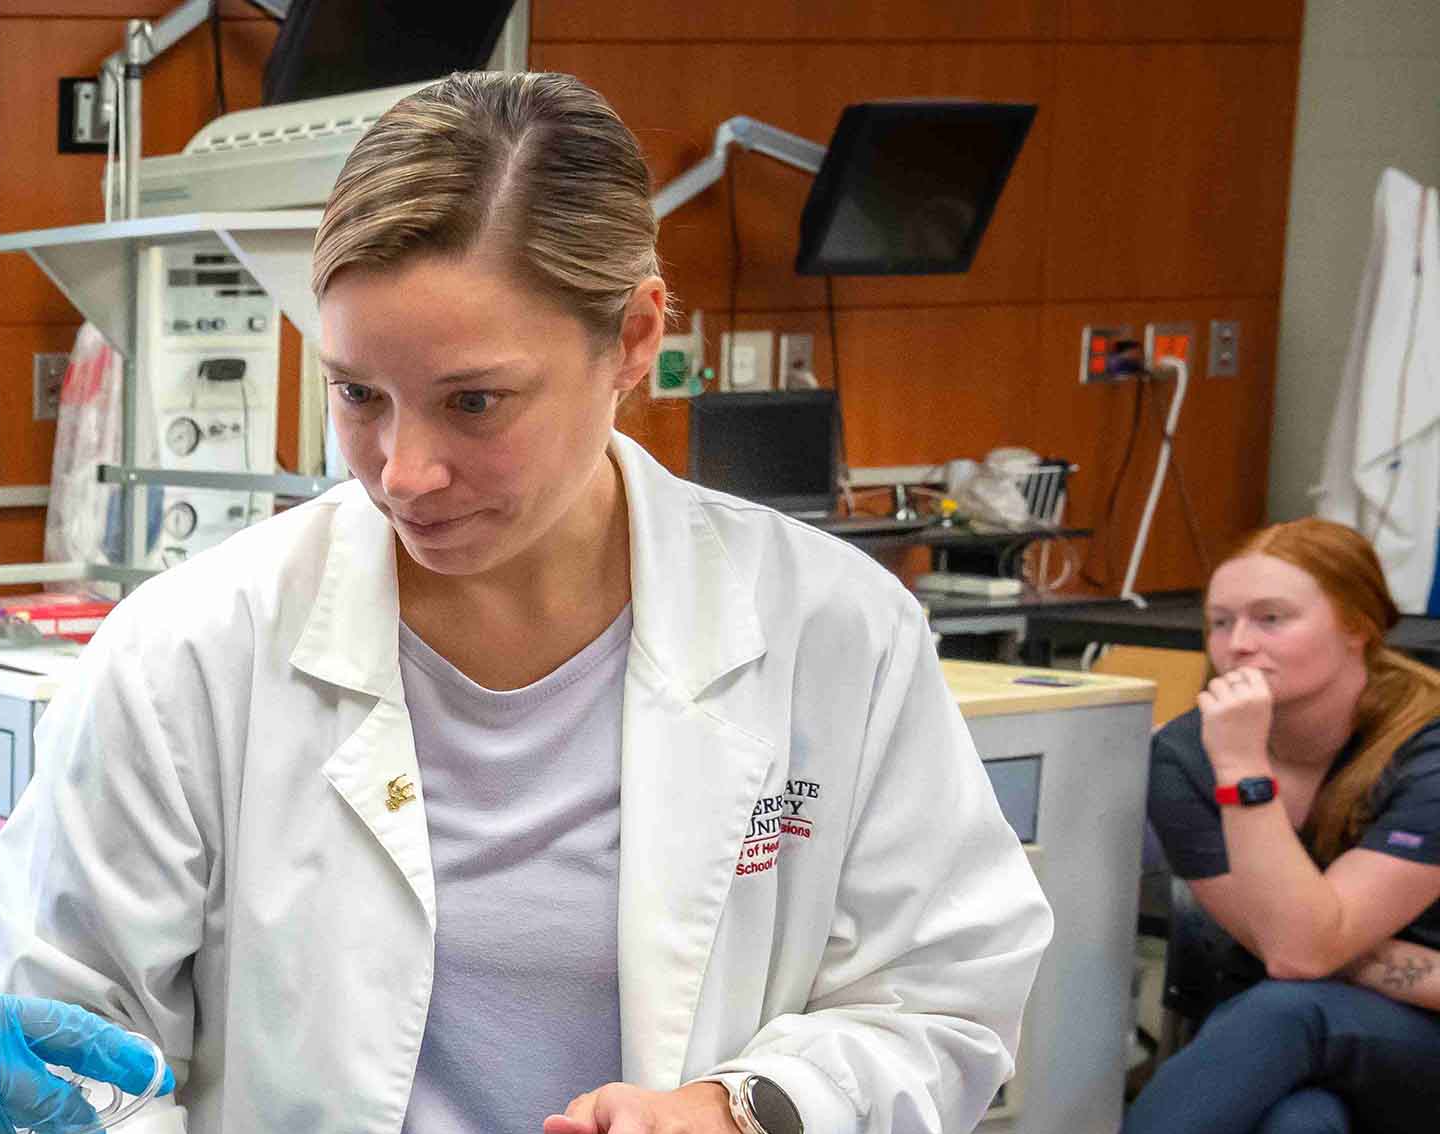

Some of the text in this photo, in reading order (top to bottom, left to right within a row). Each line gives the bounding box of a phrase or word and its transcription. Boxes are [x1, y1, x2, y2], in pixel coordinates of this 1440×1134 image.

[752, 780, 820, 816] ERR ATE
[747, 844, 760, 858] of
[780, 821, 811, 838] sions
[736, 858, 773, 876] School
